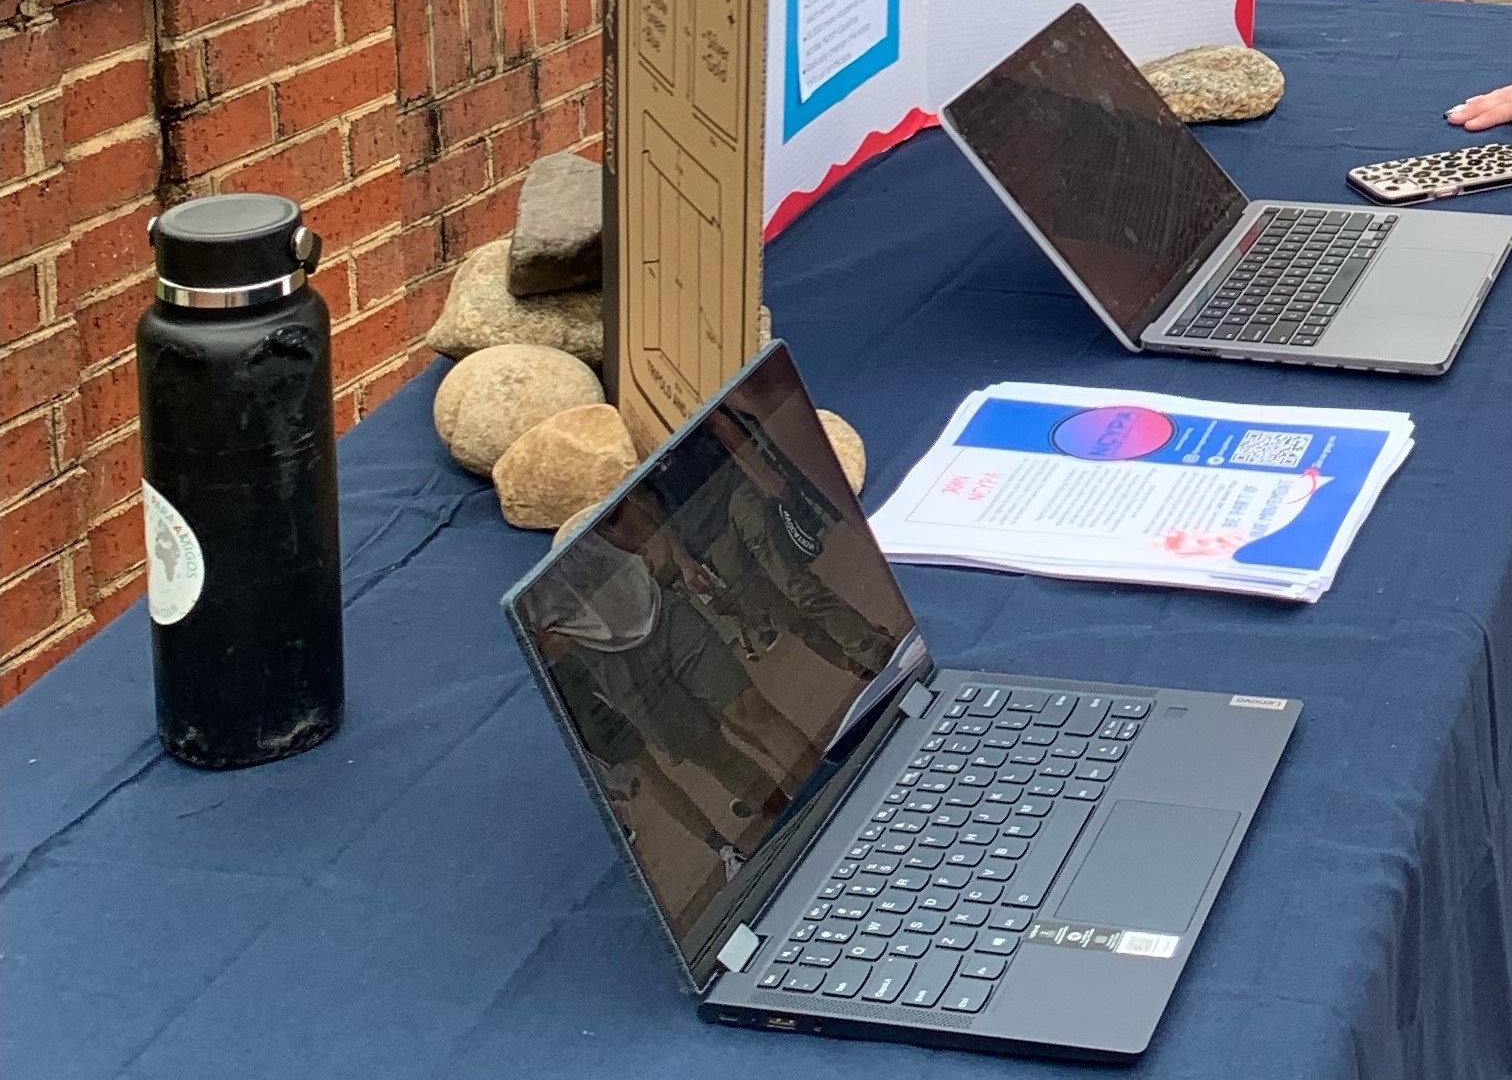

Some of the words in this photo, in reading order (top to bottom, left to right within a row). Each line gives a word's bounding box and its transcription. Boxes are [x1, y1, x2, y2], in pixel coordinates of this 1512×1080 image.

[1089, 412, 1131, 457] NCYPA
[942, 474, 970, 495] JOIN
[968, 472, 1003, 501] NCYPA
[1259, 478, 1294, 523] MOVEMENT
